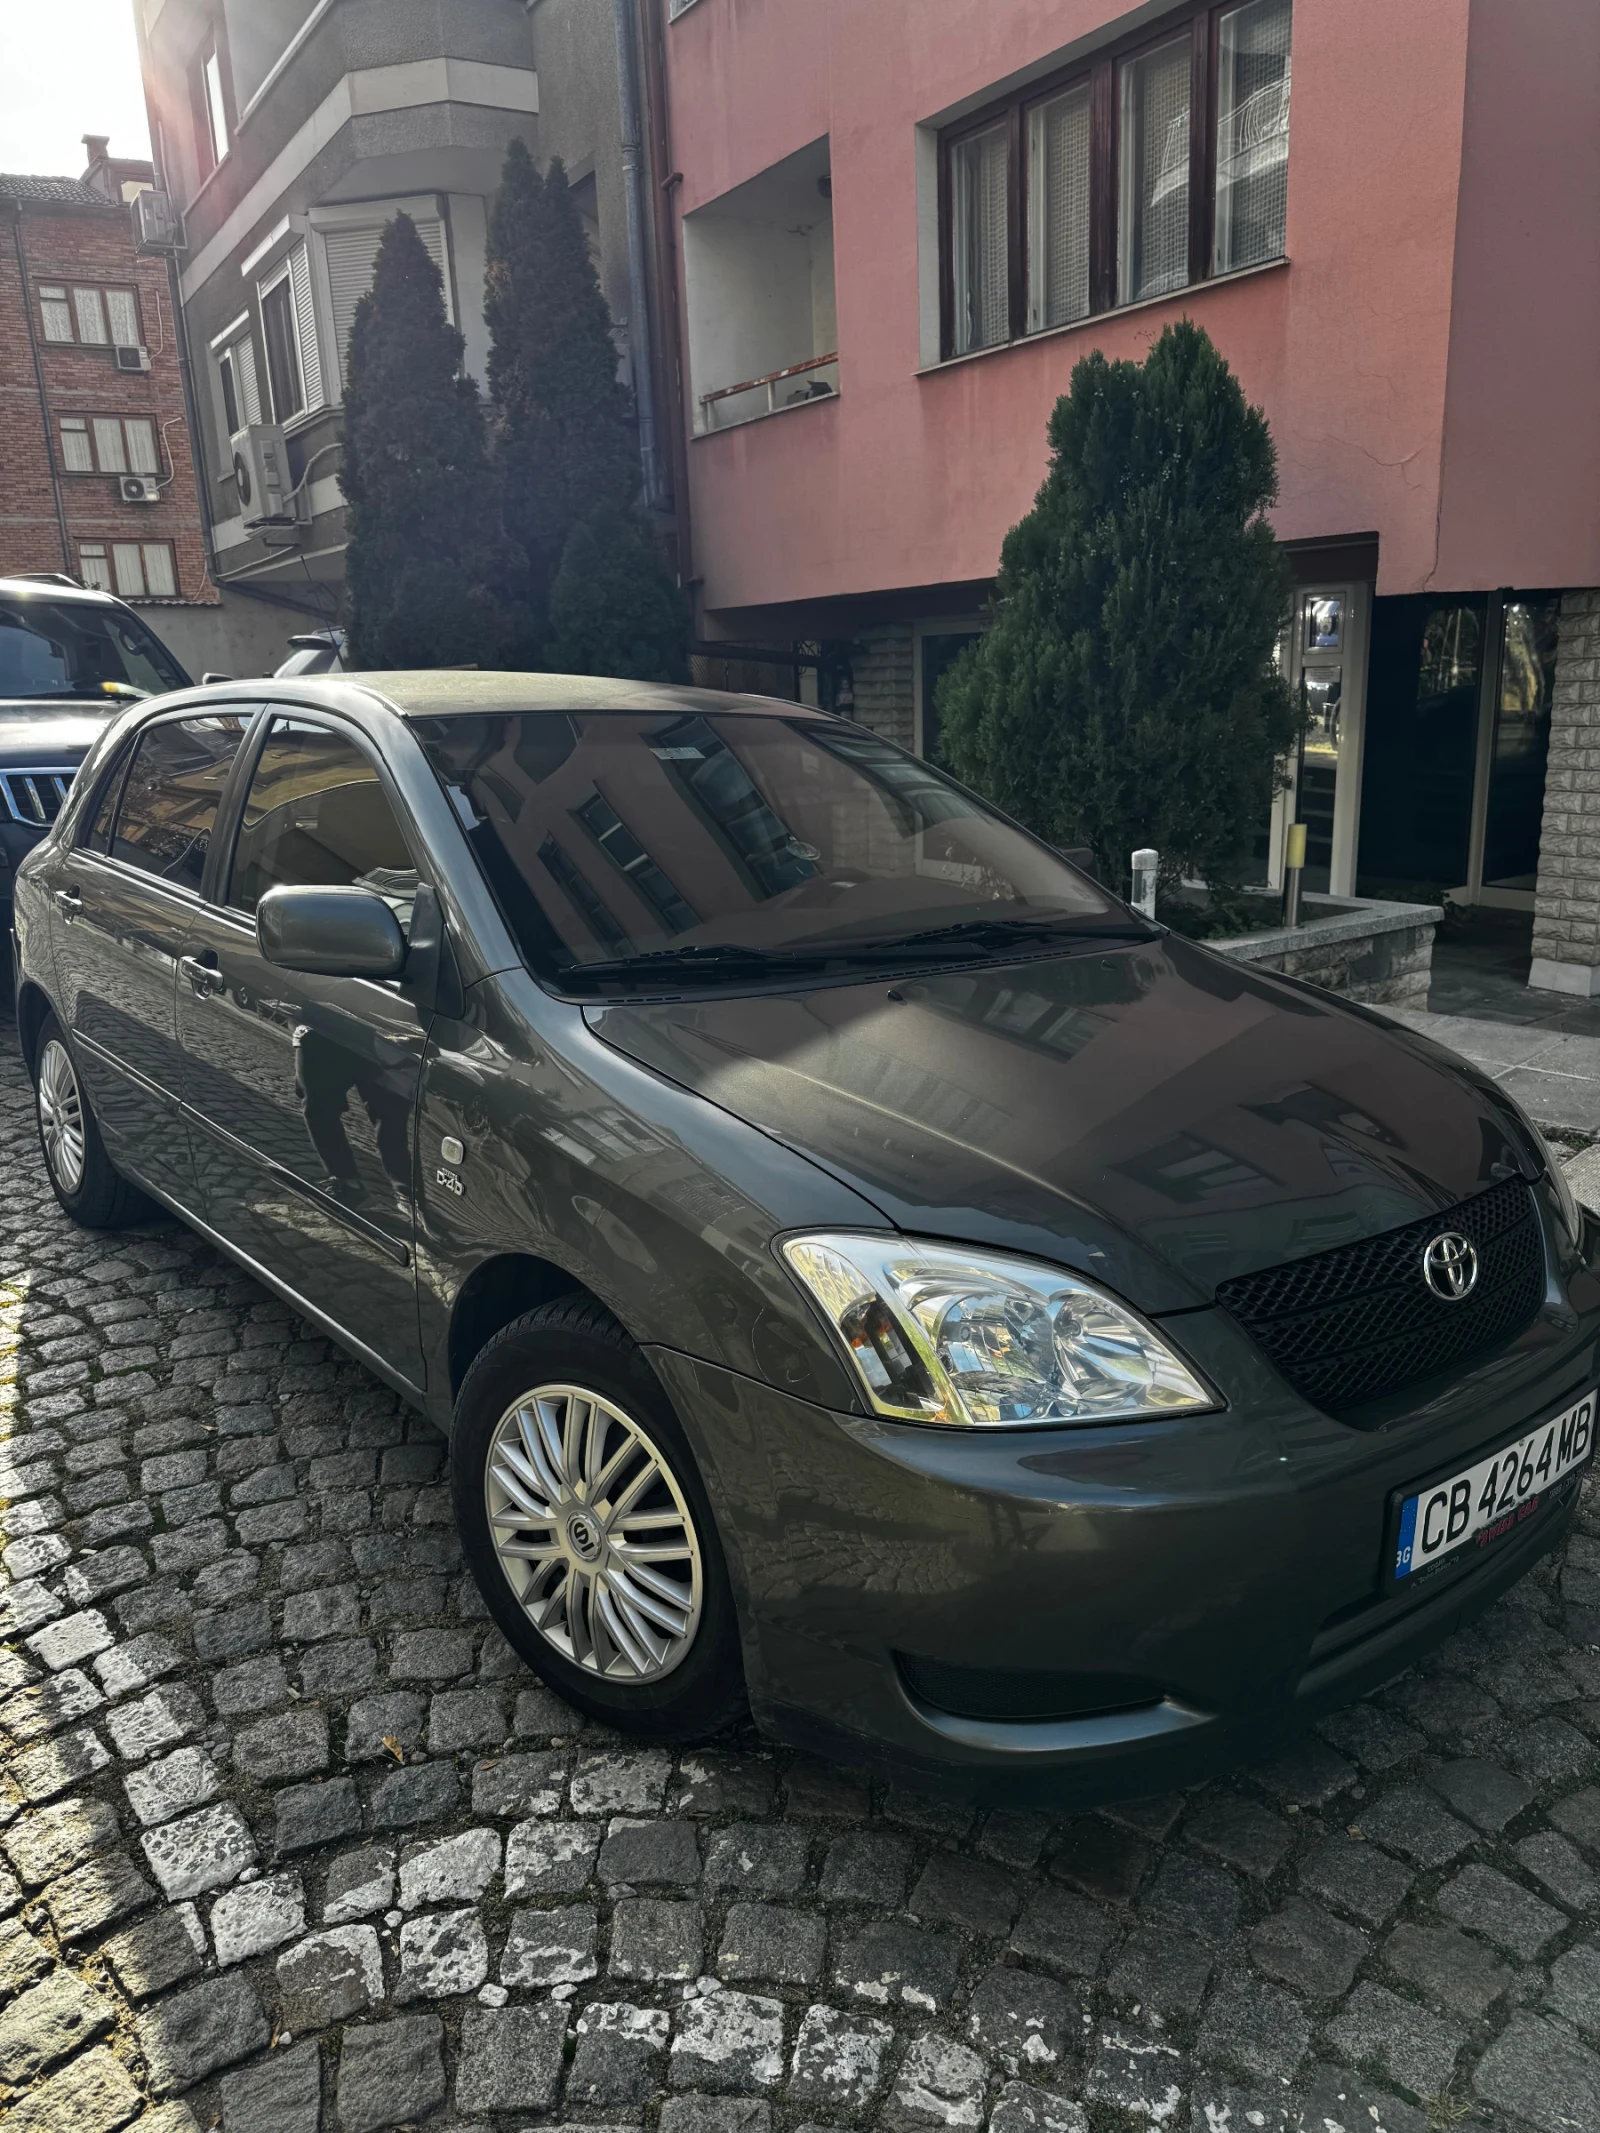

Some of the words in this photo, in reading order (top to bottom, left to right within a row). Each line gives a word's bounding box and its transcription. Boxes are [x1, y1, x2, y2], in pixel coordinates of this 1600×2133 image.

[436, 1169, 464, 1197] D-4D
[1421, 1478, 1471, 1554] CB
[1477, 1426, 1555, 1520] 4264
[1555, 1402, 1591, 1473] MB
